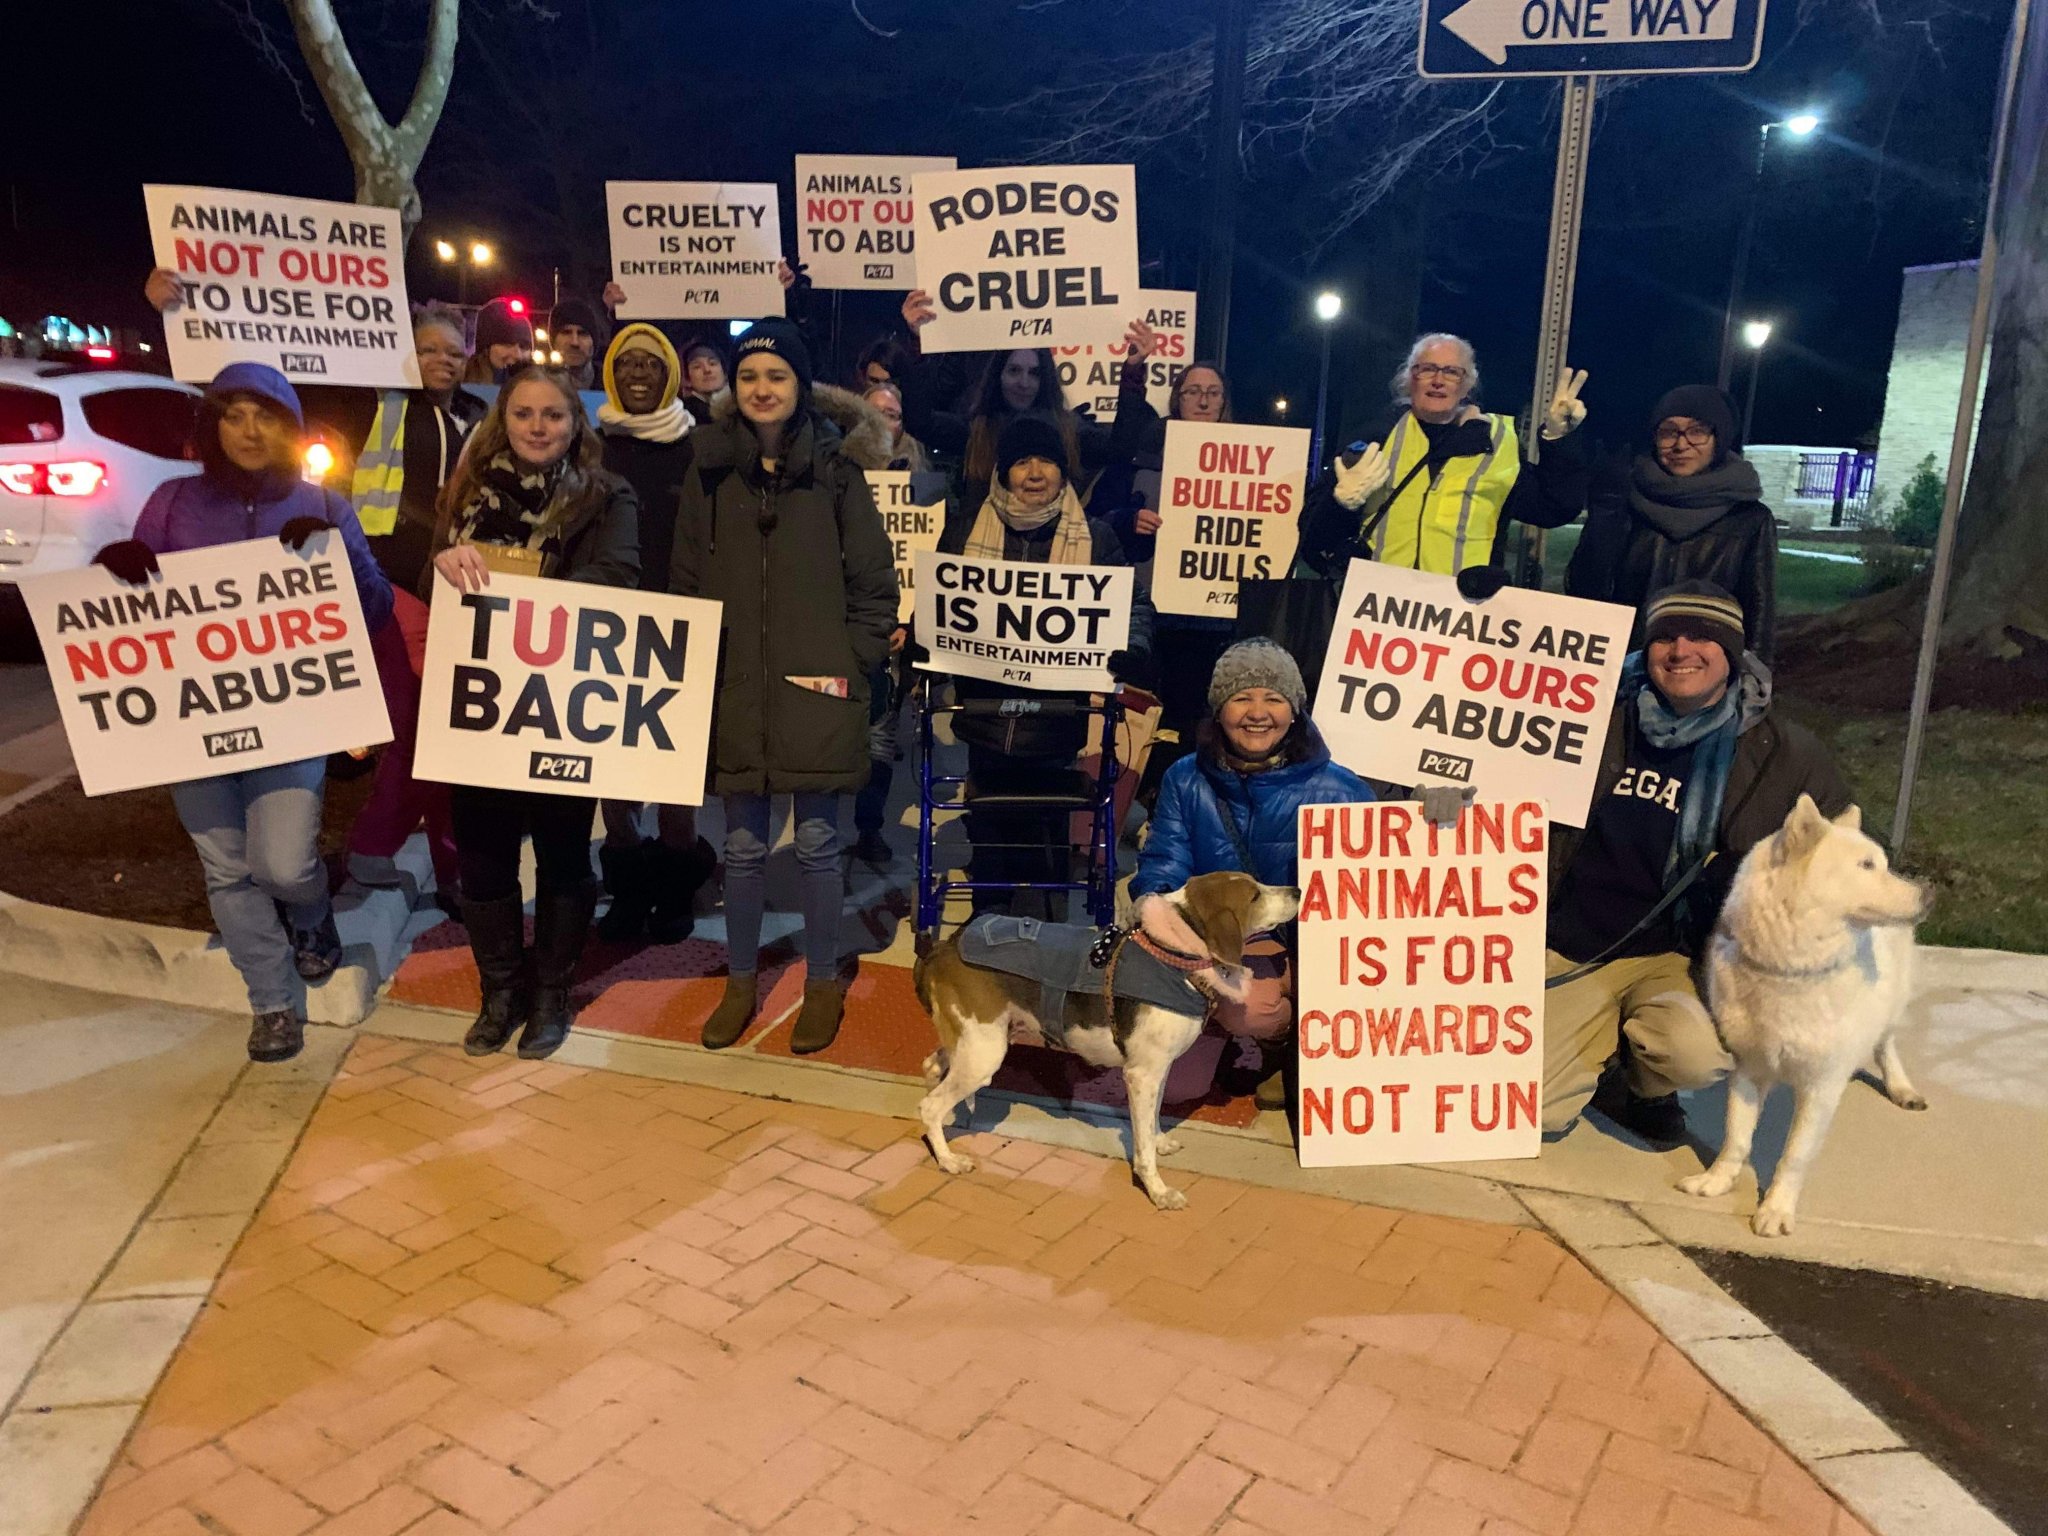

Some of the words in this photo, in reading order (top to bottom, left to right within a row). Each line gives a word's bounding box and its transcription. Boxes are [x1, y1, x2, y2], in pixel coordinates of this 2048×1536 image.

[1522, 0, 1607, 39] ONE
[1631, 0, 1722, 36] WAY
[806, 174, 902, 195] ANIMALS
[171, 203, 317, 241] ANIMALS
[327, 219, 387, 248] ARE
[622, 204, 766, 229] CRUELTY
[807, 200, 864, 224] NOT
[873, 199, 914, 224] OU
[929, 182, 1120, 232] RODEOS
[175, 237, 264, 279] NOT
[279, 248, 389, 288] OURS
[659, 236, 680, 253] IS
[688, 236, 736, 253] NOT
[807, 230, 845, 254] TO
[854, 230, 915, 254] ABU
[988, 227, 1066, 259] ARE
[620, 260, 777, 276] ENTERTAINMENT
[939, 266, 1119, 312] CRUEL
[181, 280, 231, 311] TO
[243, 287, 315, 317] USE
[324, 292, 395, 323] FOR
[1145, 309, 1186, 328] ARE
[184, 318, 398, 350] ENTERTAINMENT
[1087, 362, 1184, 387] ABSE
[1199, 441, 1275, 475] ONLY
[1172, 477, 1293, 514] BULLIES
[883, 512, 934, 533] REN:
[1194, 515, 1263, 548] RIDE
[936, 562, 1112, 601] CRUELTY
[1179, 550, 1272, 582] BULLS
[56, 578, 242, 634] ANIMALS
[256, 562, 337, 603] ARE
[936, 594, 978, 633] IS
[997, 603, 1110, 644] NOT
[65, 630, 176, 683] NOT
[196, 602, 348, 662] OURS
[461, 593, 689, 682] TURN
[1353, 592, 1522, 649] ANIMALS
[1529, 626, 1610, 666] ARE
[936, 635, 1105, 667] ENTERTAINMENT
[1343, 628, 1451, 682] NOT
[1461, 653, 1600, 714] OURS
[78, 686, 157, 731] TO
[179, 650, 361, 720] ABUSE
[450, 664, 680, 751] BACK
[1337, 674, 1401, 722] TO
[1412, 693, 1589, 765] ABUSE
[1302, 802, 1544, 859] HURTING
[1298, 863, 1539, 922] ANIMALS
[1340, 936, 1387, 986] IS
[1406, 934, 1514, 986] FOR
[1300, 1004, 1533, 1059] COWARDS
[1303, 1084, 1409, 1136] NOT
[1435, 1081, 1538, 1133] FUN
